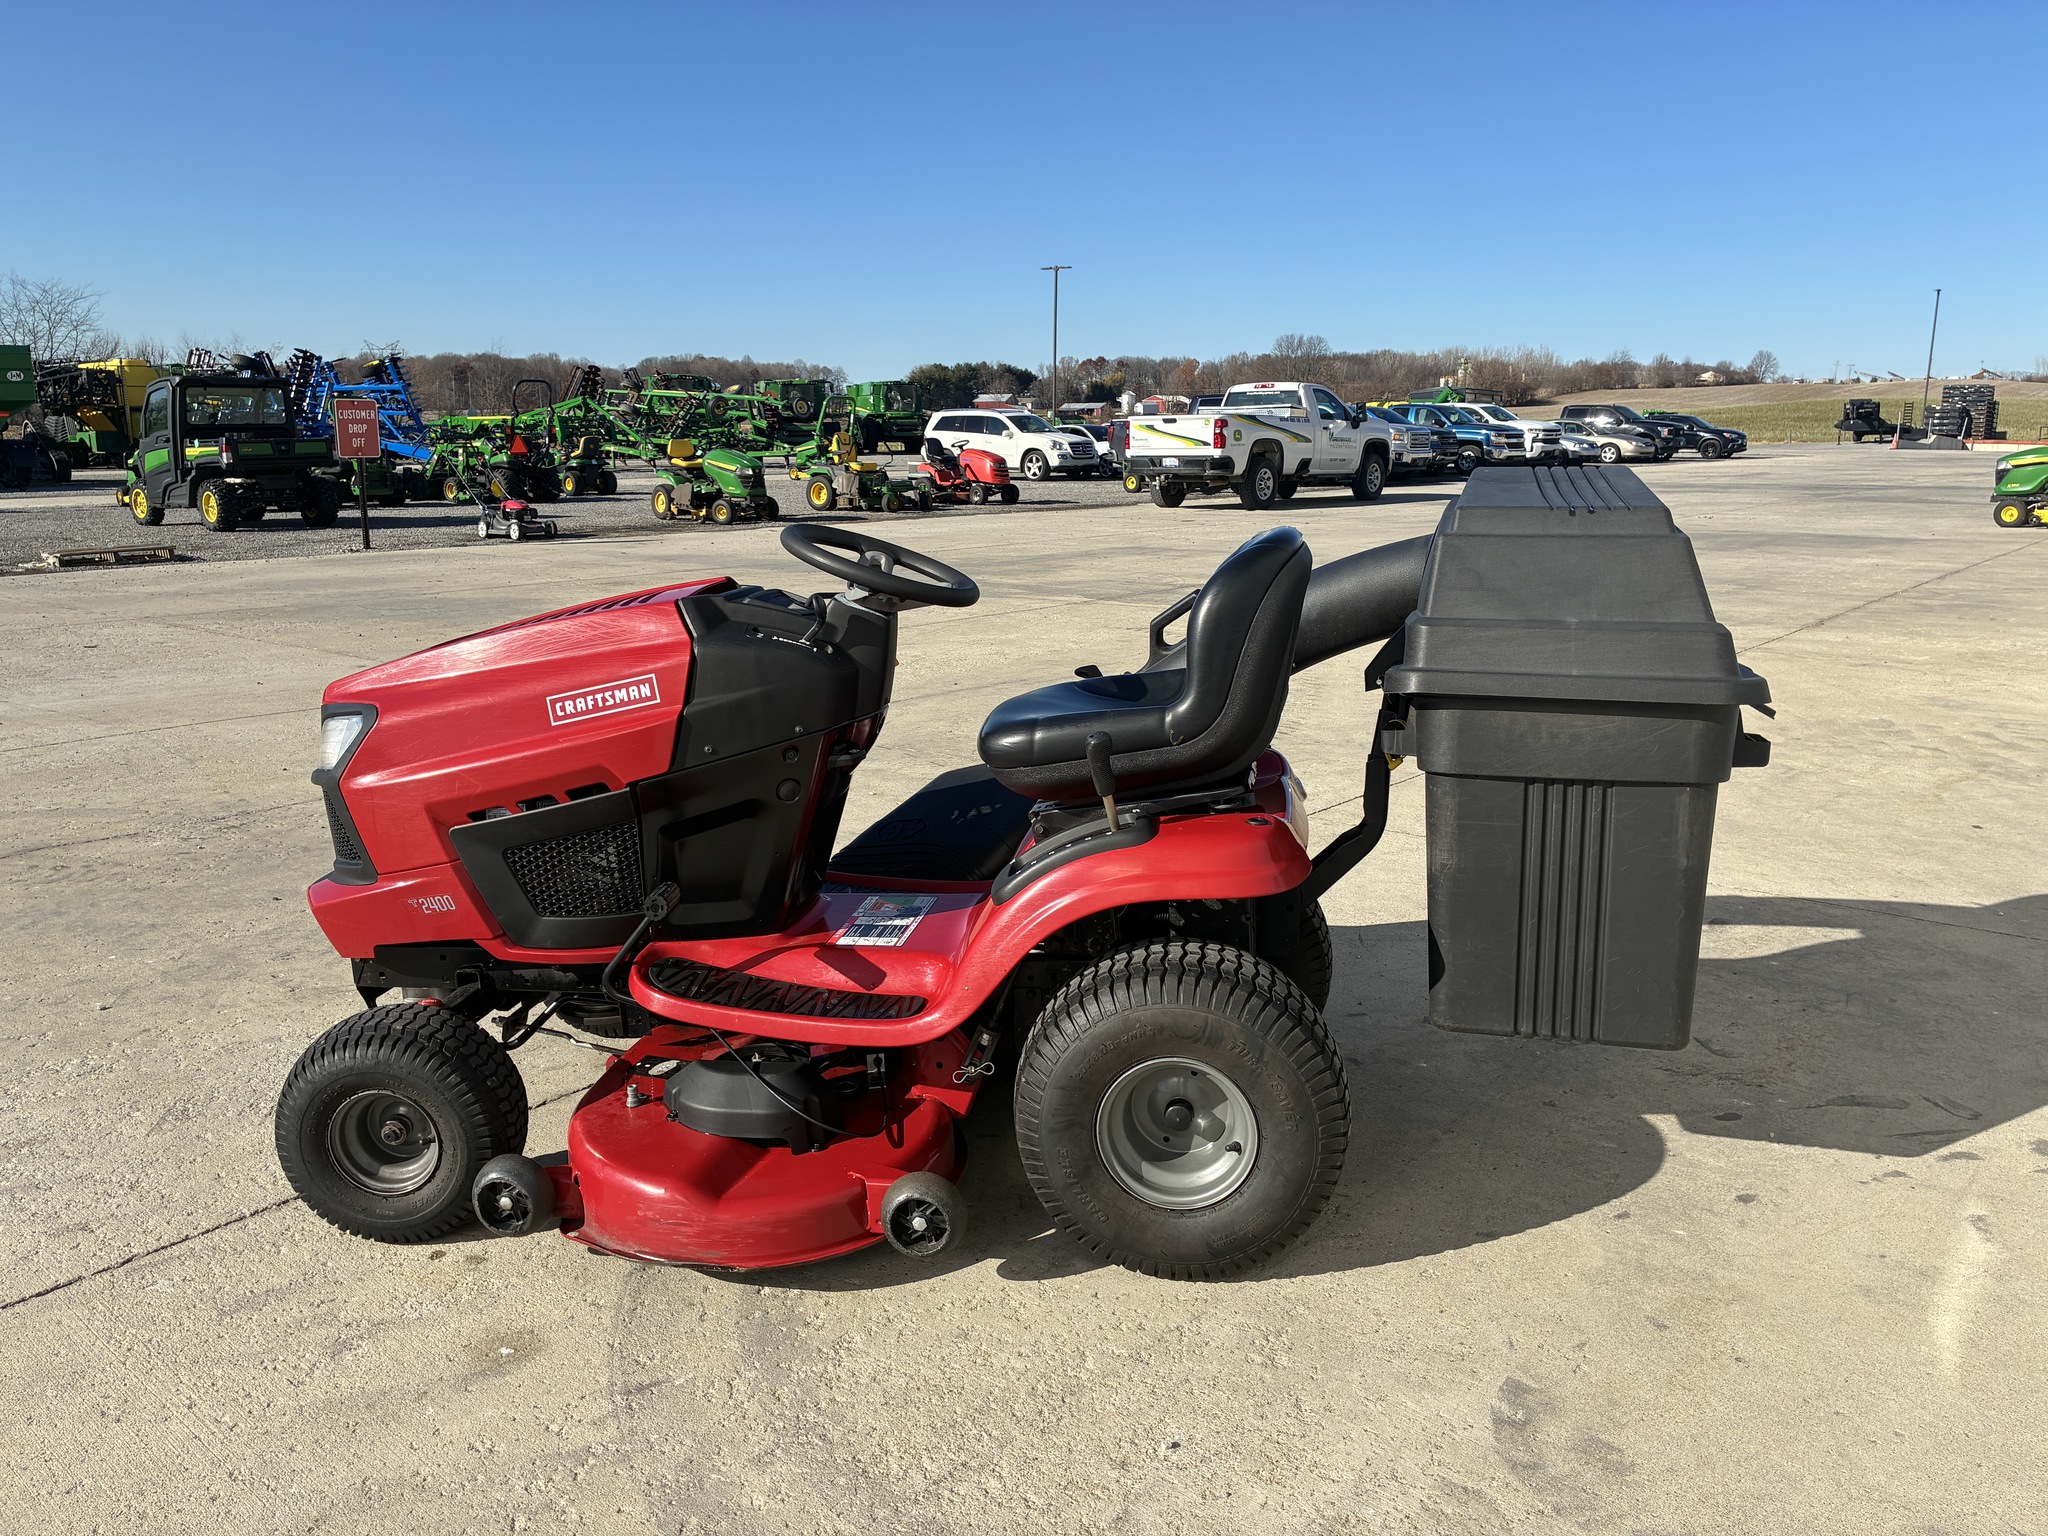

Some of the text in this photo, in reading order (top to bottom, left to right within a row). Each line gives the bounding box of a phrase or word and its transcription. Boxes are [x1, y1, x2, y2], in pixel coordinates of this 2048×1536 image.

[338, 409, 376, 420] CUSTOMER
[348, 423, 367, 434] DROP
[352, 437, 366, 448] OFF
[555, 682, 651, 717] CRAFTSMAN
